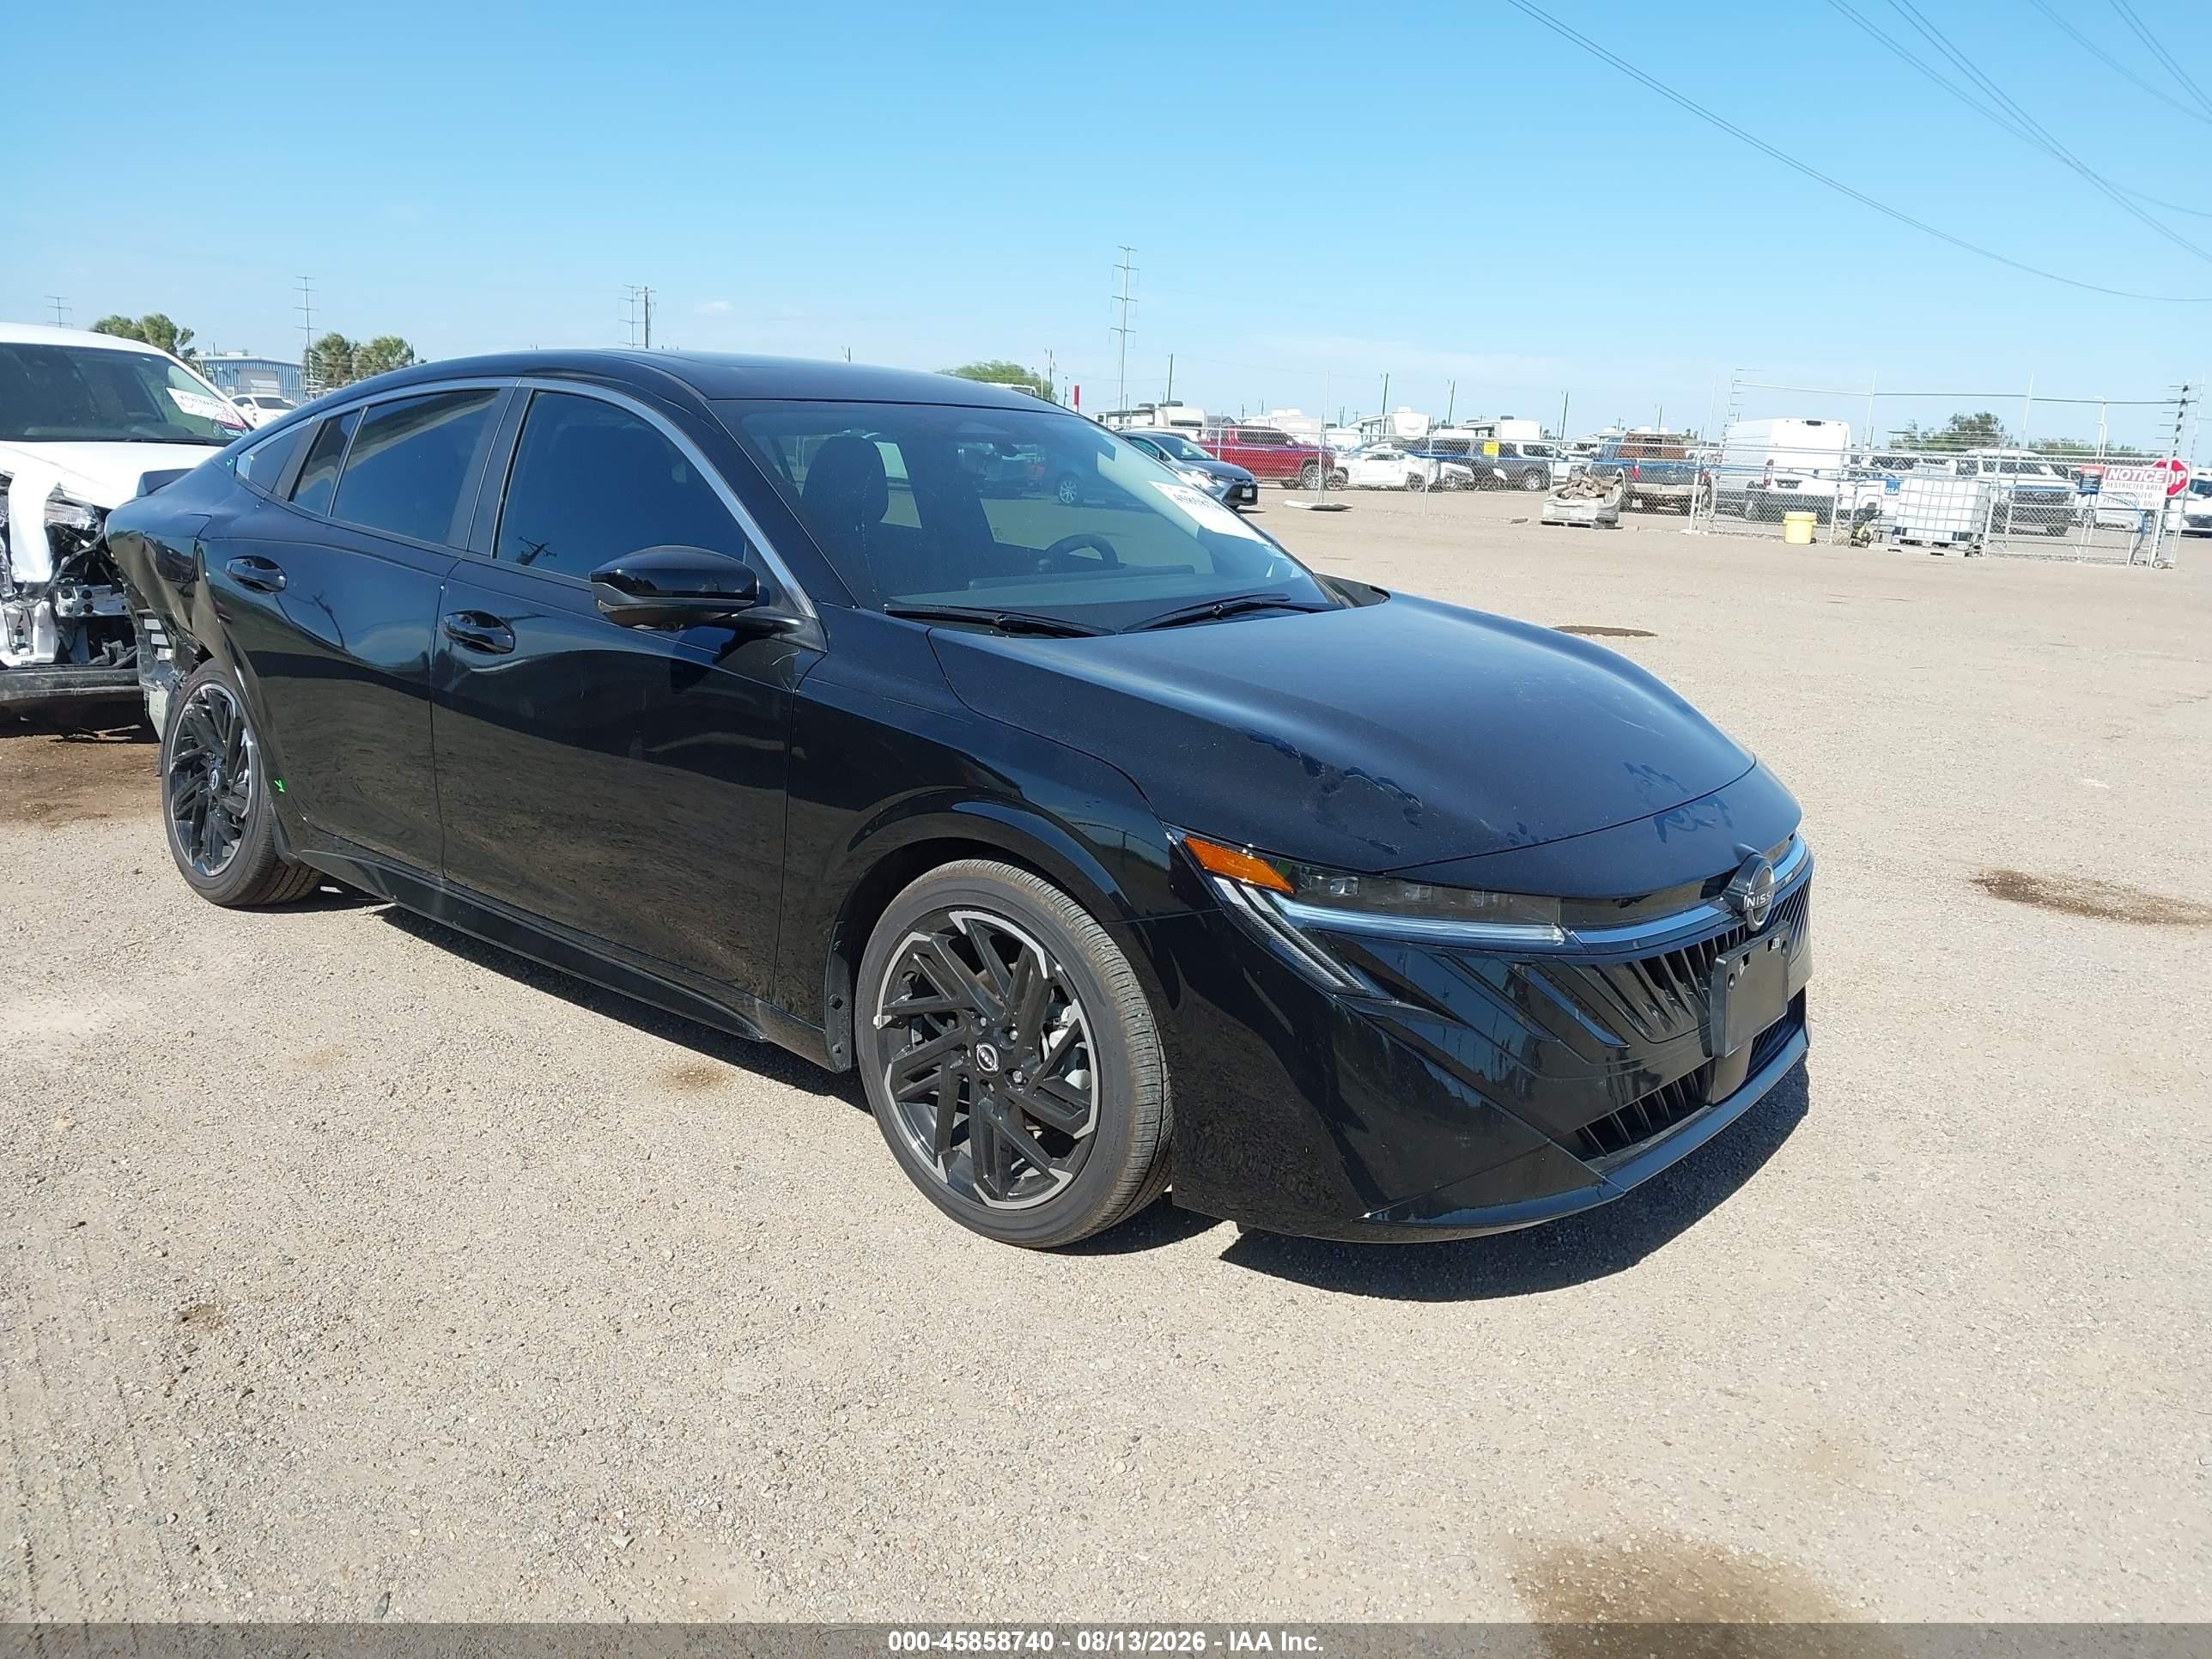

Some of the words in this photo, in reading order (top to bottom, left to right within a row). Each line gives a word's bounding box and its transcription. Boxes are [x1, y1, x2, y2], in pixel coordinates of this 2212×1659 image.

[2107, 468, 2165, 483] NOTICE
[2167, 470, 2186, 485] OP
[1747, 891, 1771, 908] NISS
